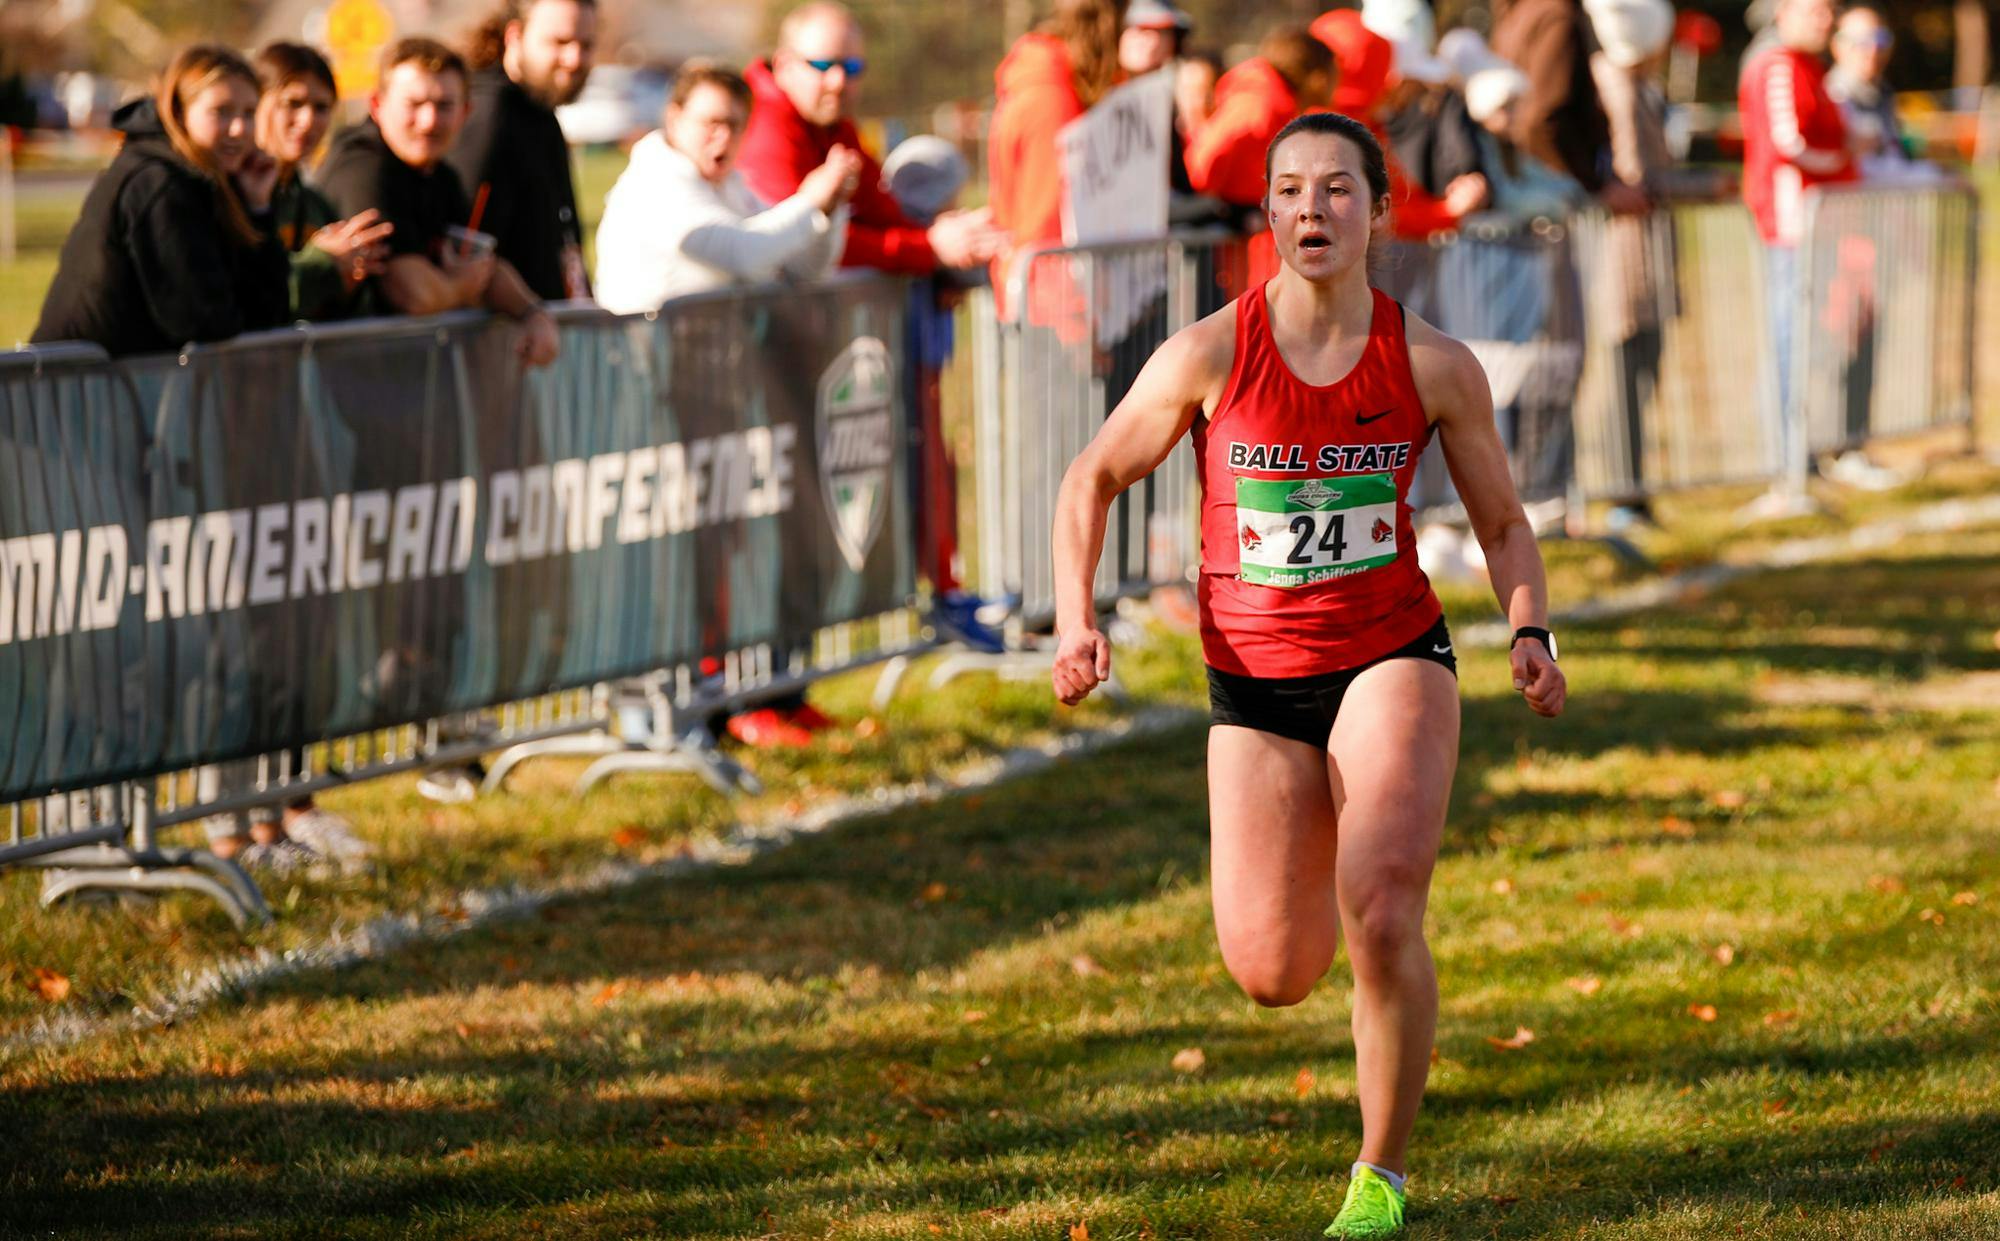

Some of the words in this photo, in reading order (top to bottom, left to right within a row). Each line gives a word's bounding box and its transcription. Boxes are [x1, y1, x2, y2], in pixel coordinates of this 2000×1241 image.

[1228, 442, 1308, 471] BALL
[1316, 442, 1412, 472] STATE
[0, 475, 477, 645] MID-AMERICAN
[485, 422, 797, 567] CONFERENCE
[1287, 515, 1348, 564] 24
[1268, 569, 1304, 584] Jenna
